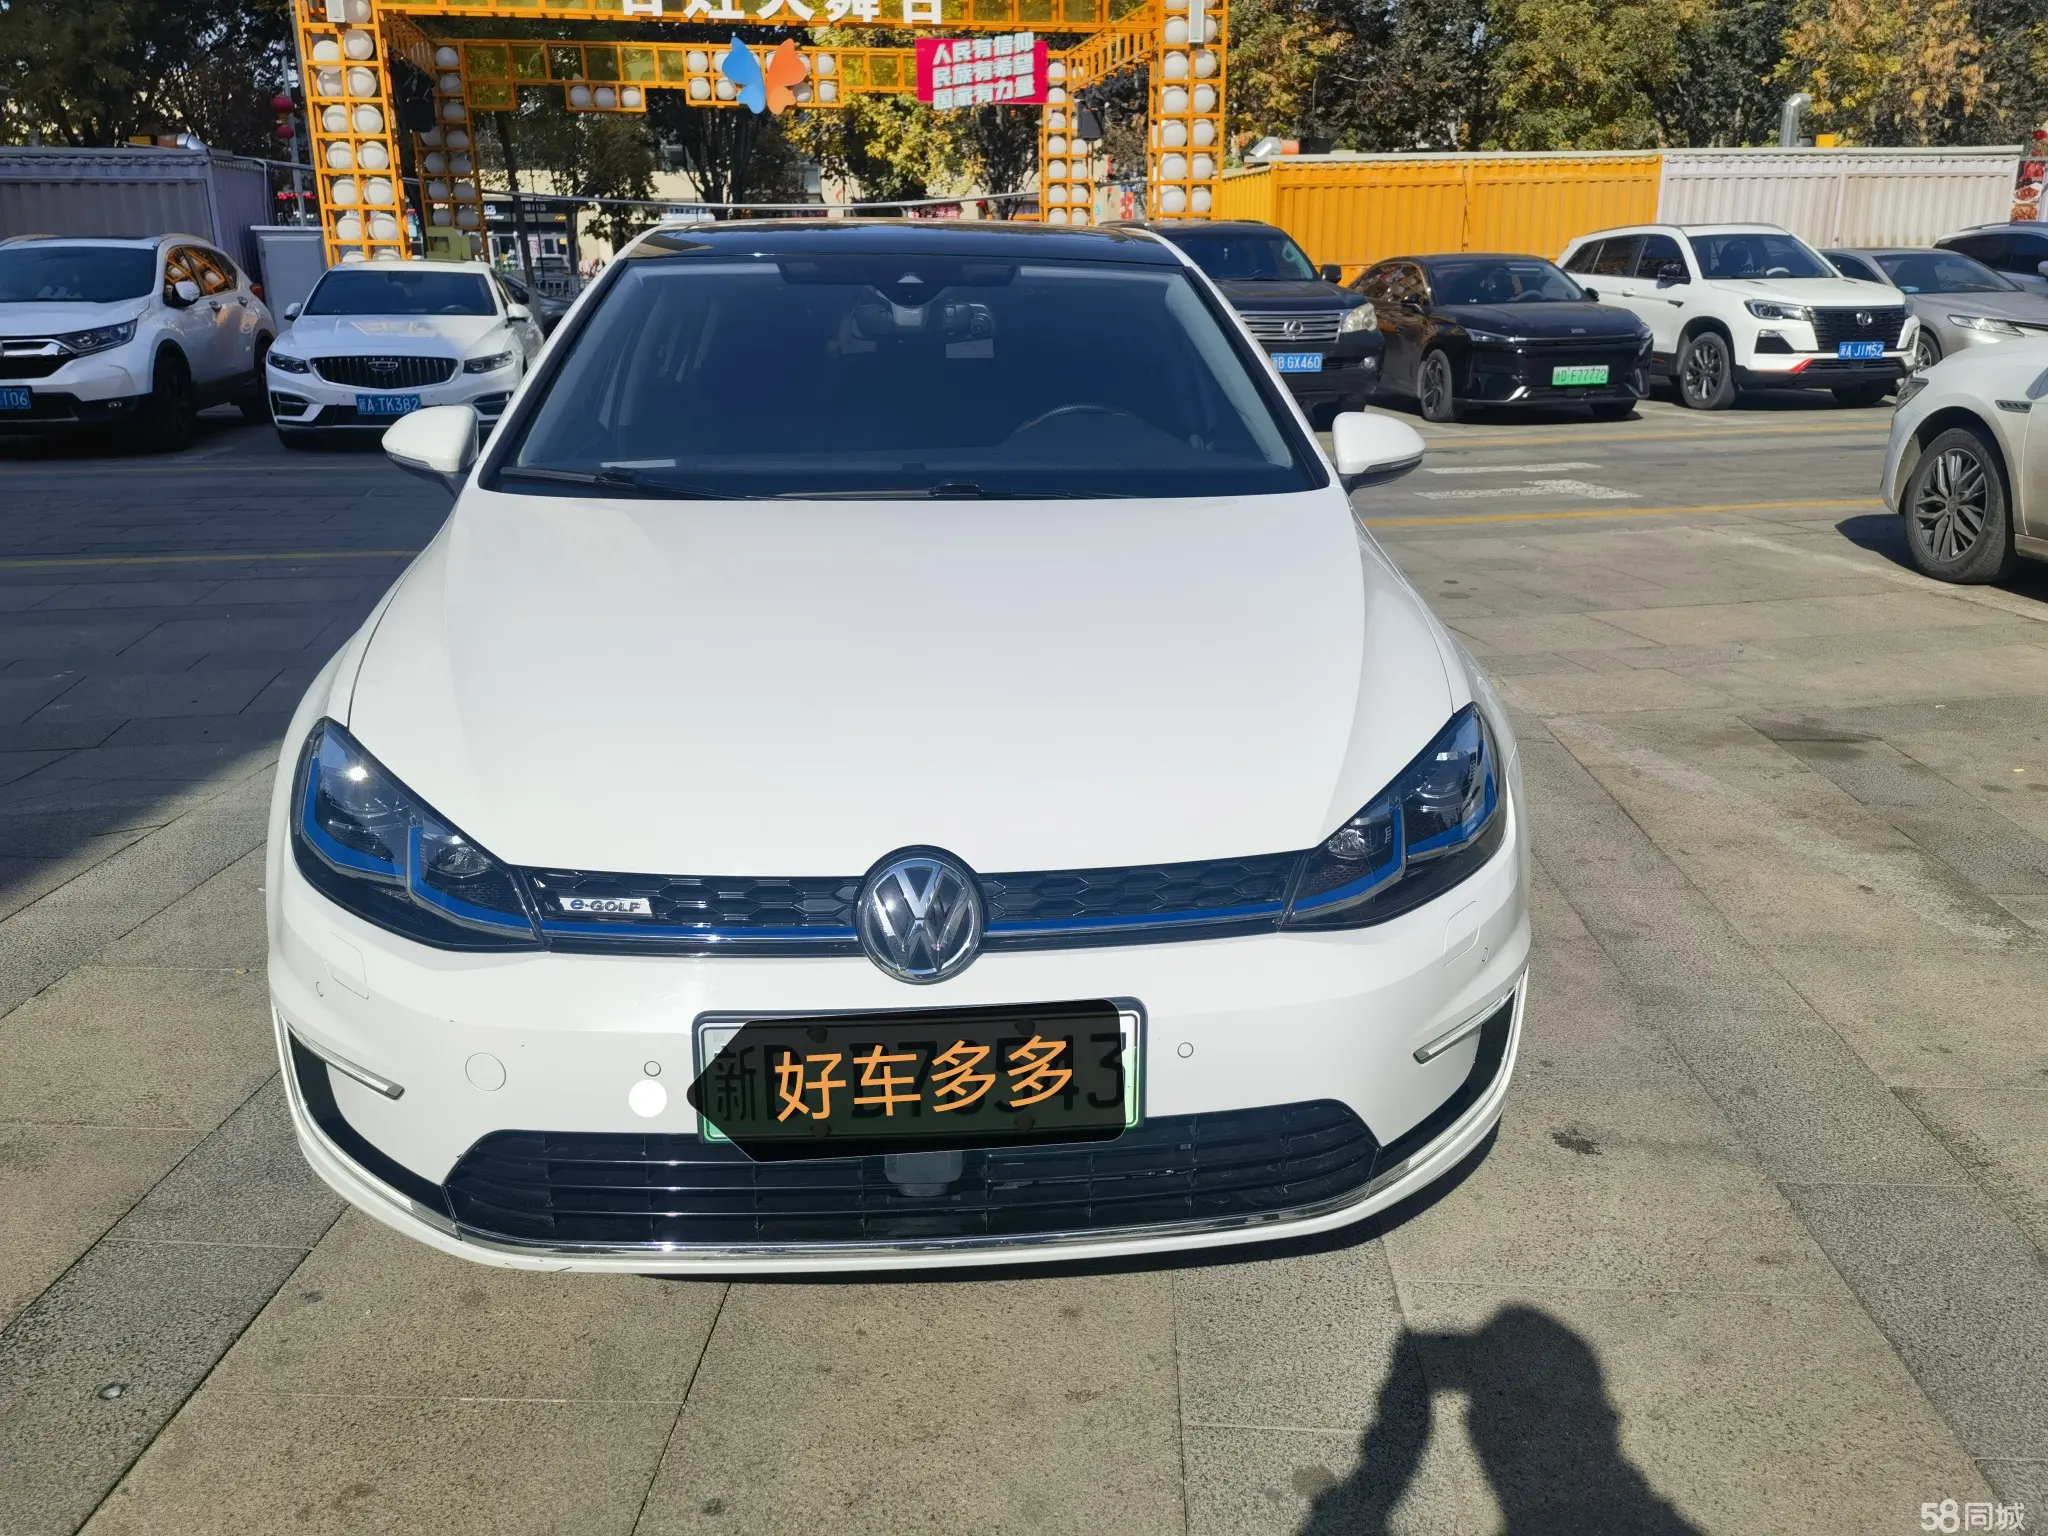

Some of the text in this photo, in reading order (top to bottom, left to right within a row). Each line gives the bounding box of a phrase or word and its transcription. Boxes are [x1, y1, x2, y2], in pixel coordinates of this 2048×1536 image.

[932, 32, 1034, 66] 人民有信仰
[932, 52, 1034, 88] 民族有希望
[933, 75, 1036, 110] 国家有力量
[570, 899, 641, 912] e-GOLF
